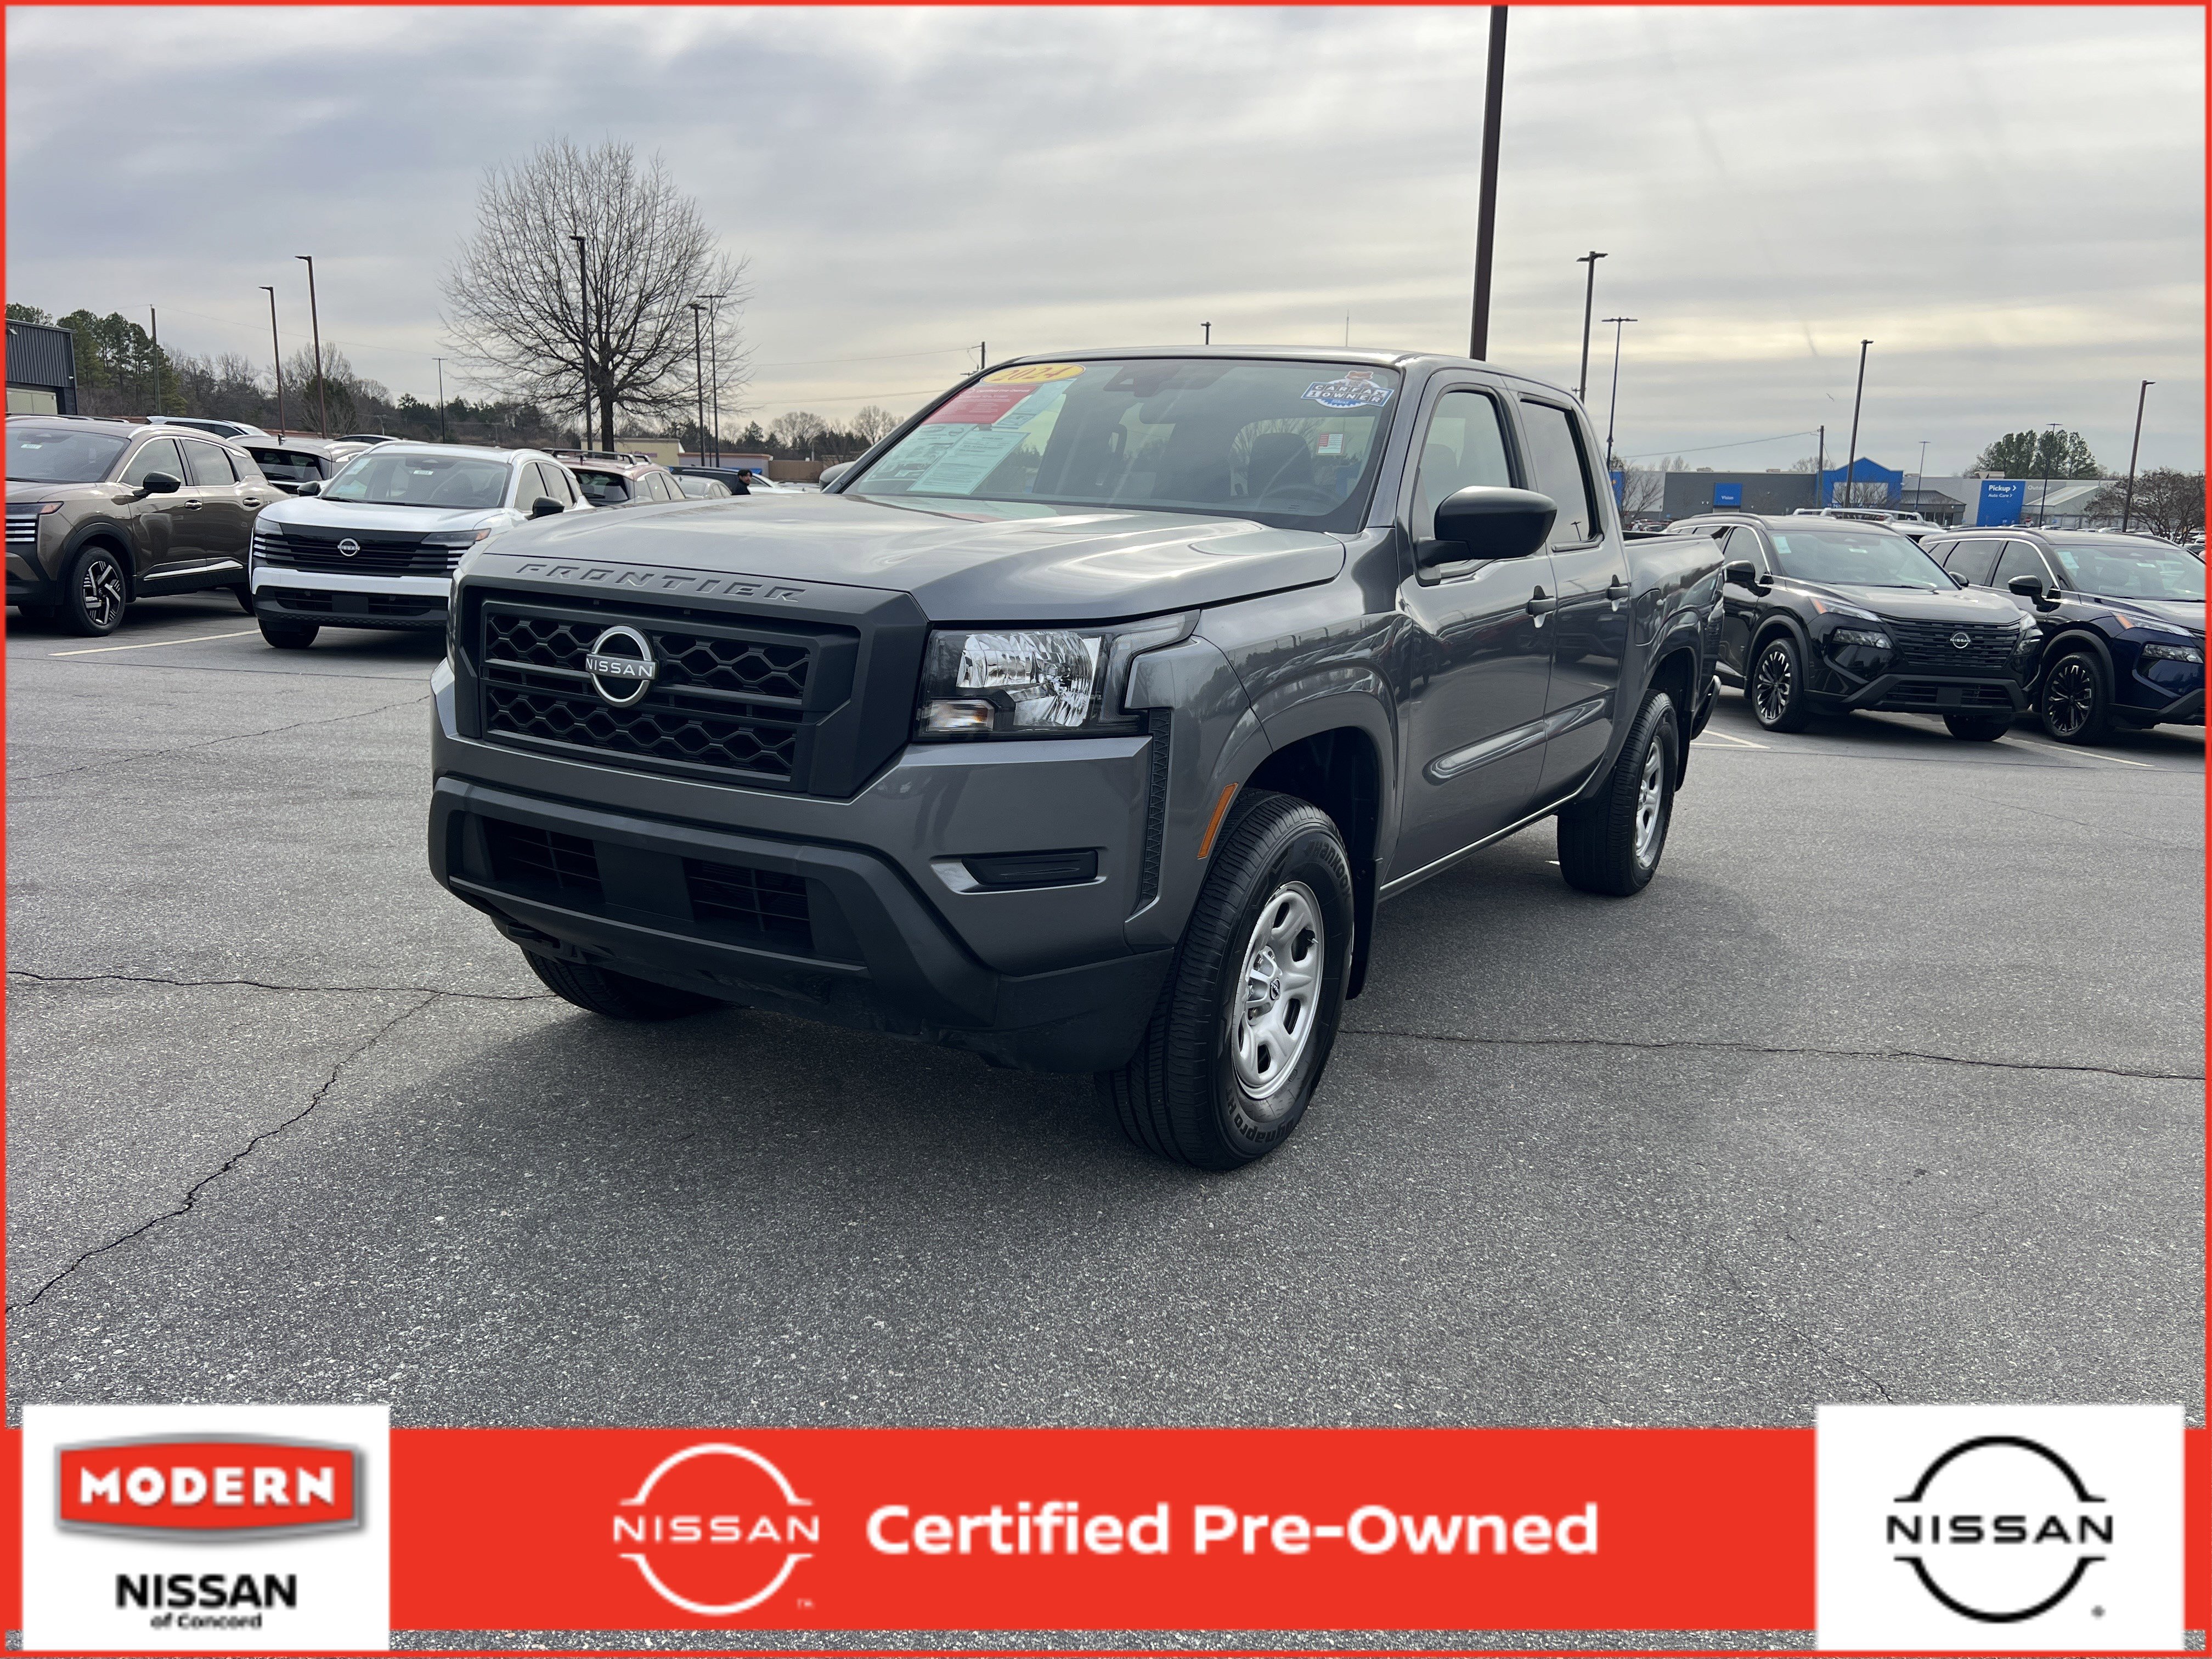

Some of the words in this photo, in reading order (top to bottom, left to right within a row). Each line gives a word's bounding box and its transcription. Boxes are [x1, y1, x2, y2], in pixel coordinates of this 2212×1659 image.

[990, 366, 1074, 382] 2024
[1315, 385, 1385, 397] CARFAX
[1322, 392, 1381, 403] OWNER
[1988, 484, 2011, 493] Pickup
[516, 563, 806, 602] FRONTIER
[586, 658, 653, 678] NISSAN
